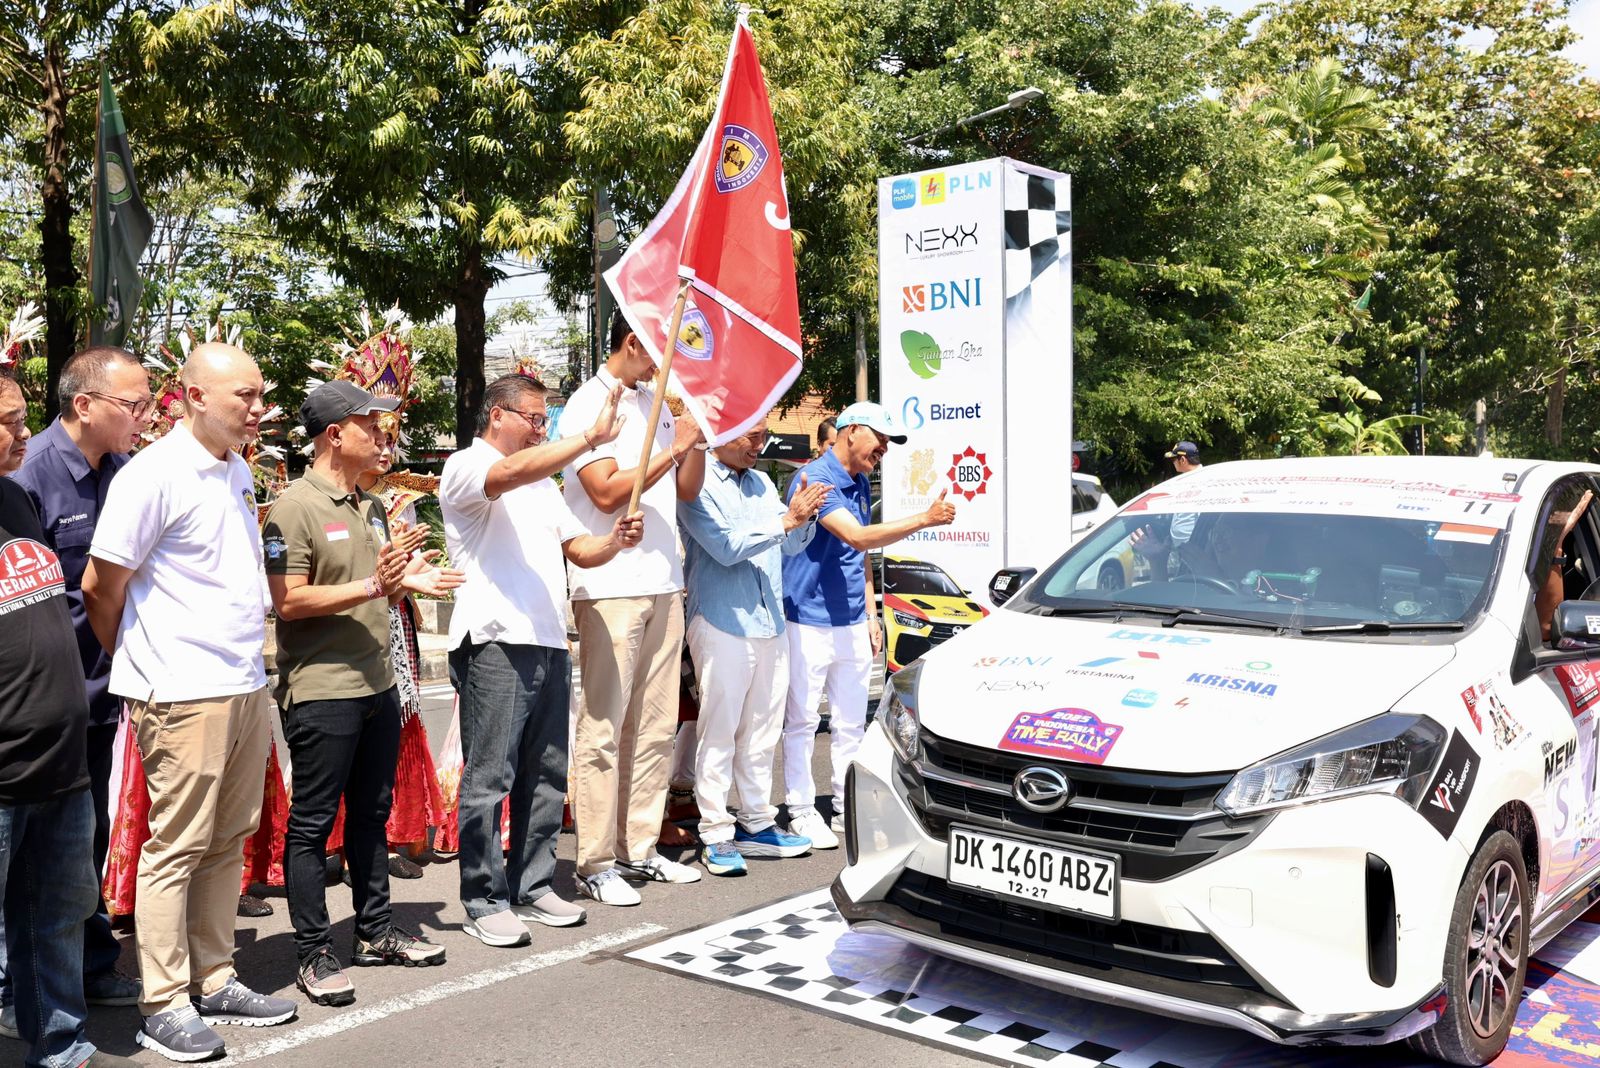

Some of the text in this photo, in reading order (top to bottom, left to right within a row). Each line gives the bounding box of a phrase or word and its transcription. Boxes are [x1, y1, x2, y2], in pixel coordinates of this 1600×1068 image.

[893, 187, 906, 195] PLN
[949, 170, 992, 194] PLN
[893, 193, 914, 202] mobile
[905, 222, 978, 254] NEXX
[930, 277, 982, 311] BNI
[930, 402, 981, 421] Biznet
[958, 465, 981, 483] BBS
[1463, 501, 1493, 515] 11
[1065, 669, 1135, 681] PERTAMINA
[1052, 711, 1092, 723] 2025
[1033, 719, 1096, 735] INDONESIA
[1011, 725, 1110, 753] TIME RALLY
[1454, 758, 1472, 796] TRANSPORT
[954, 833, 1110, 897] DK 1460 ABZ
